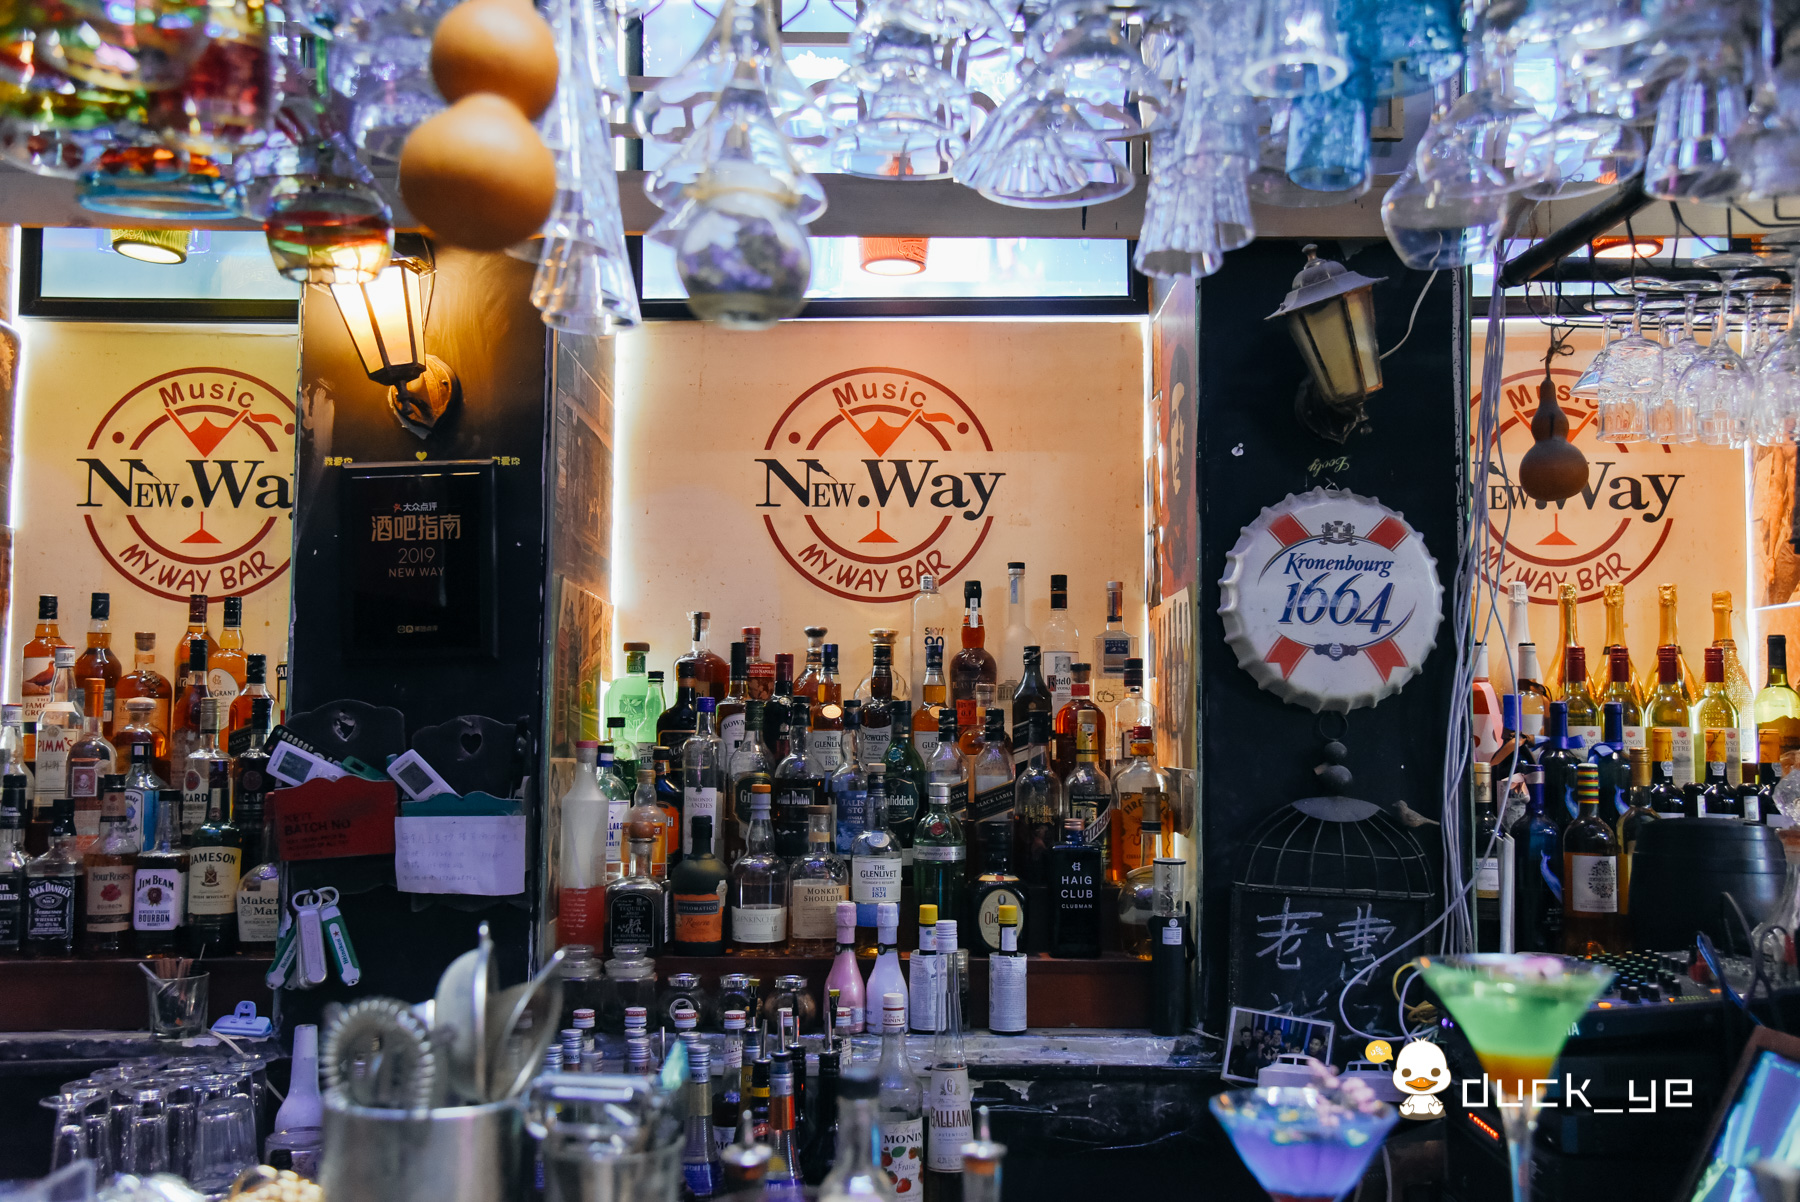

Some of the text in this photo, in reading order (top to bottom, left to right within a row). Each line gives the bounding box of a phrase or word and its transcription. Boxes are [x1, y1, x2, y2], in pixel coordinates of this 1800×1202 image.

[158, 381, 255, 408] Music
[831, 380, 927, 408] Music
[402, 502, 438, 512] 大众点评
[371, 514, 461, 542] 酒吧指南
[398, 547, 436, 564] 2019
[219, 550, 275, 590] BAR
[388, 566, 445, 578] NEW WAY
[897, 549, 952, 590] BAR
[1283, 552, 1395, 582] Kronenbourg
[1576, 552, 1631, 591] BAR
[1278, 571, 1395, 634] 1664
[284, 821, 328, 836] BATCH
[190, 852, 237, 866] JAMESON
[860, 869, 898, 879] GLENLIVET
[1061, 875, 1093, 886] HAIG
[28, 884, 45, 898] JACK
[45, 881, 73, 898] DANIEL'S
[136, 874, 174, 892] JIM BEAM
[806, 887, 840, 895] MONKEY
[871, 890, 887, 898] 1824
[1060, 889, 1093, 899] CLUB
[803, 895, 843, 903] SHOULDER
[138, 914, 170, 923] BOURBON
[253, 907, 278, 916] Mar
[984, 911, 999, 925] Old
[930, 1106, 972, 1128] GALLIANO
